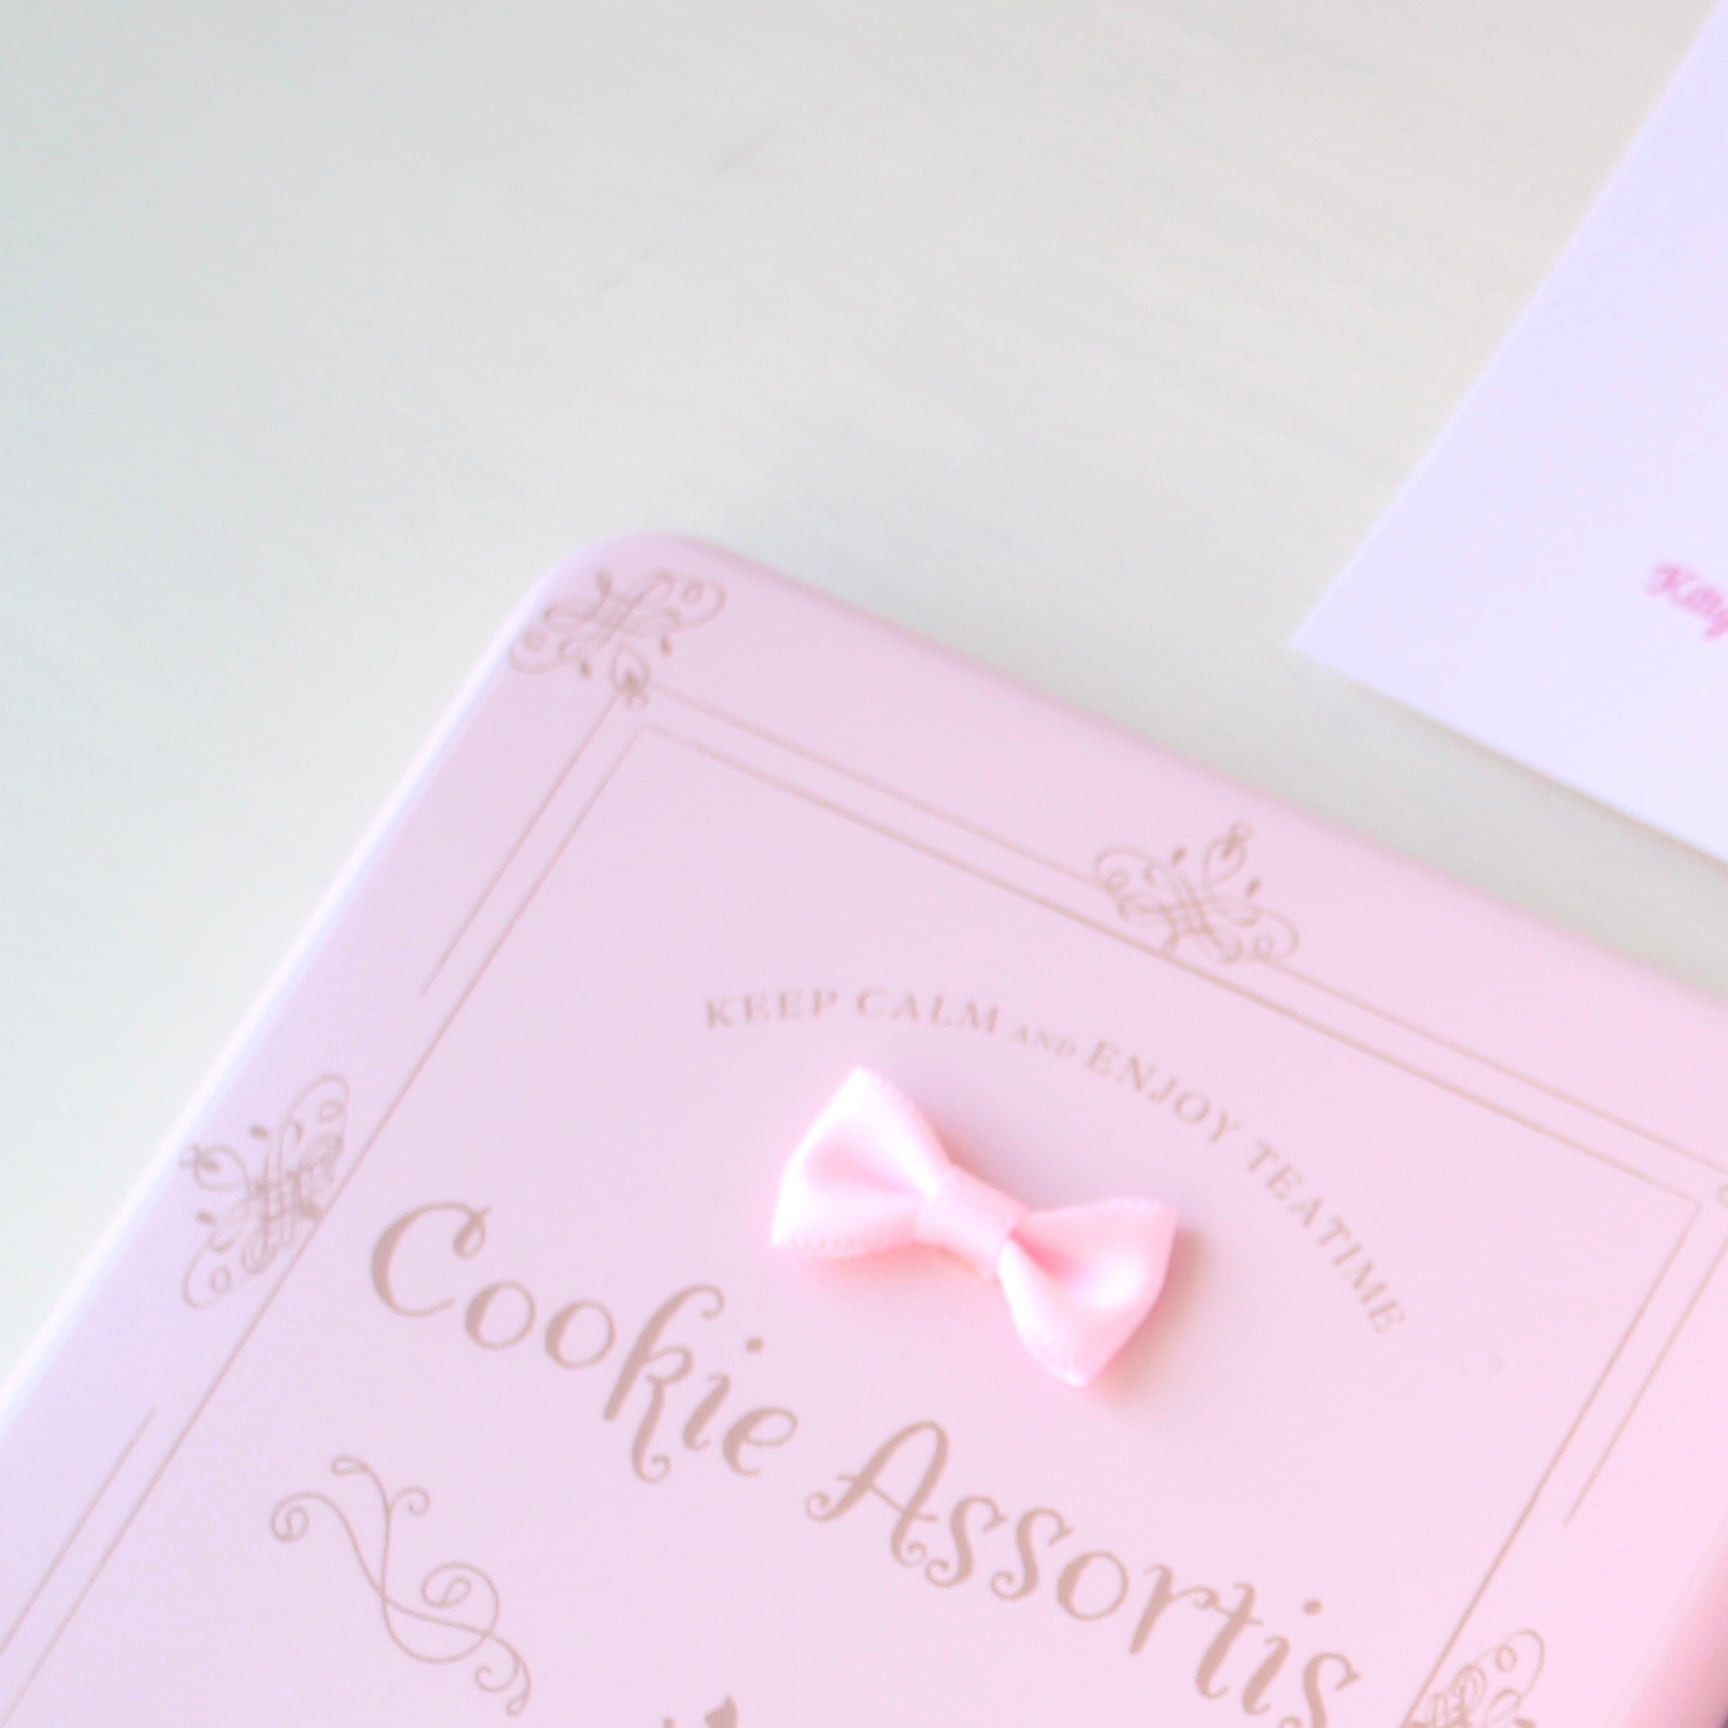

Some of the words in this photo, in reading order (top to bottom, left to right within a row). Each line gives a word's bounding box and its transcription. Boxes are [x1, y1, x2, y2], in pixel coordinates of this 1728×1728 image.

[704, 987, 840, 1032] KEEP
[854, 987, 1001, 1036] CALM
[1008, 1021, 1078, 1060] AND
[1083, 1041, 1245, 1147] ENJOY
[1244, 1139, 1407, 1336] TEATIME
[368, 1200, 799, 1484] Cookie
